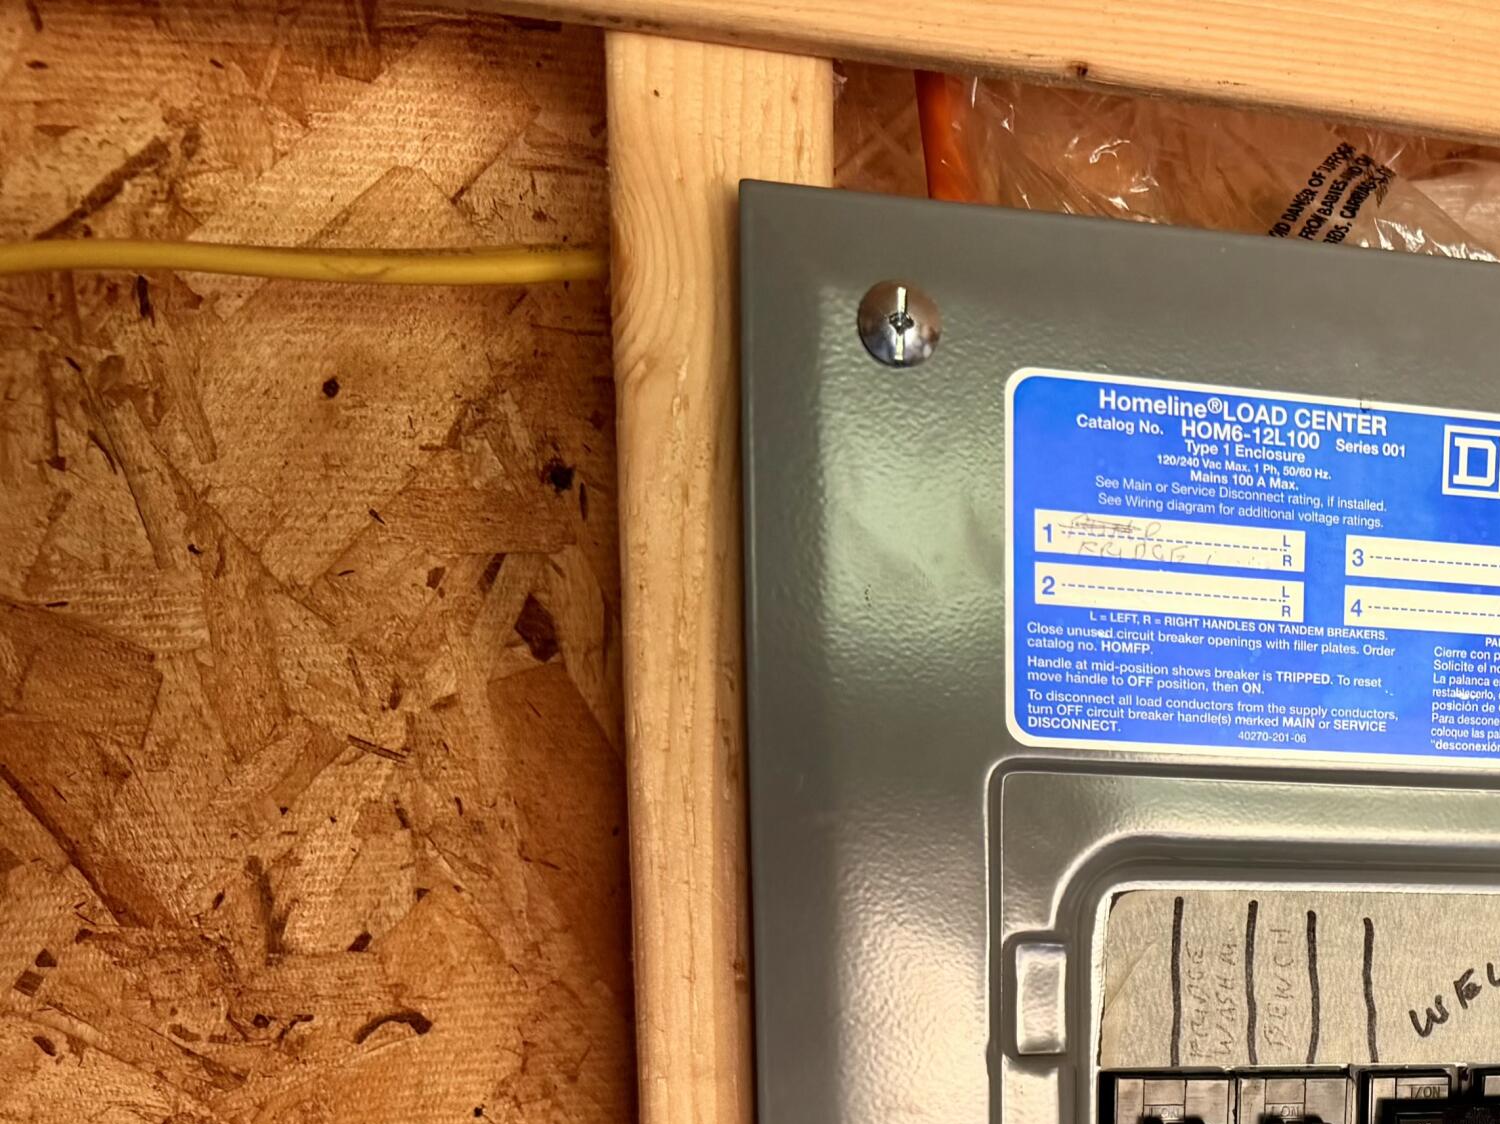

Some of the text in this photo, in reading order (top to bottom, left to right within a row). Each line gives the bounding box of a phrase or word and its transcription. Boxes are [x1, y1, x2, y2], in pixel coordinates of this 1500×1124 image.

[1098, 386, 1388, 436] Homeline® LOAD CENTER
[1076, 414, 1405, 457] Catalog No. HOM6-12L100 Series 001
[1184, 440, 1305, 463] Type 1 Enclosure
[1157, 454, 1199, 468] 120/240
[1201, 458, 1221, 470] Vac
[1254, 462, 1258, 473] 1
[1283, 464, 1312, 477] 50/60
[1190, 470, 1298, 490] Mains 100 A Max.
[1095, 476, 1387, 511] See Main or Service Disconnect rating, if installed.
[1098, 493, 1383, 530] See Wiring diagram for additional voltage ratings.
[1043, 524, 1053, 543] 1
[1351, 549, 1365, 567] 3
[1041, 576, 1055, 595] 2
[1350, 599, 1363, 616] 4
[1027, 636, 1153, 655] catalog no. HOMFP.
[1028, 716, 1121, 732] DISCONNECT.
[1238, 730, 1306, 743] 40270-201-06
